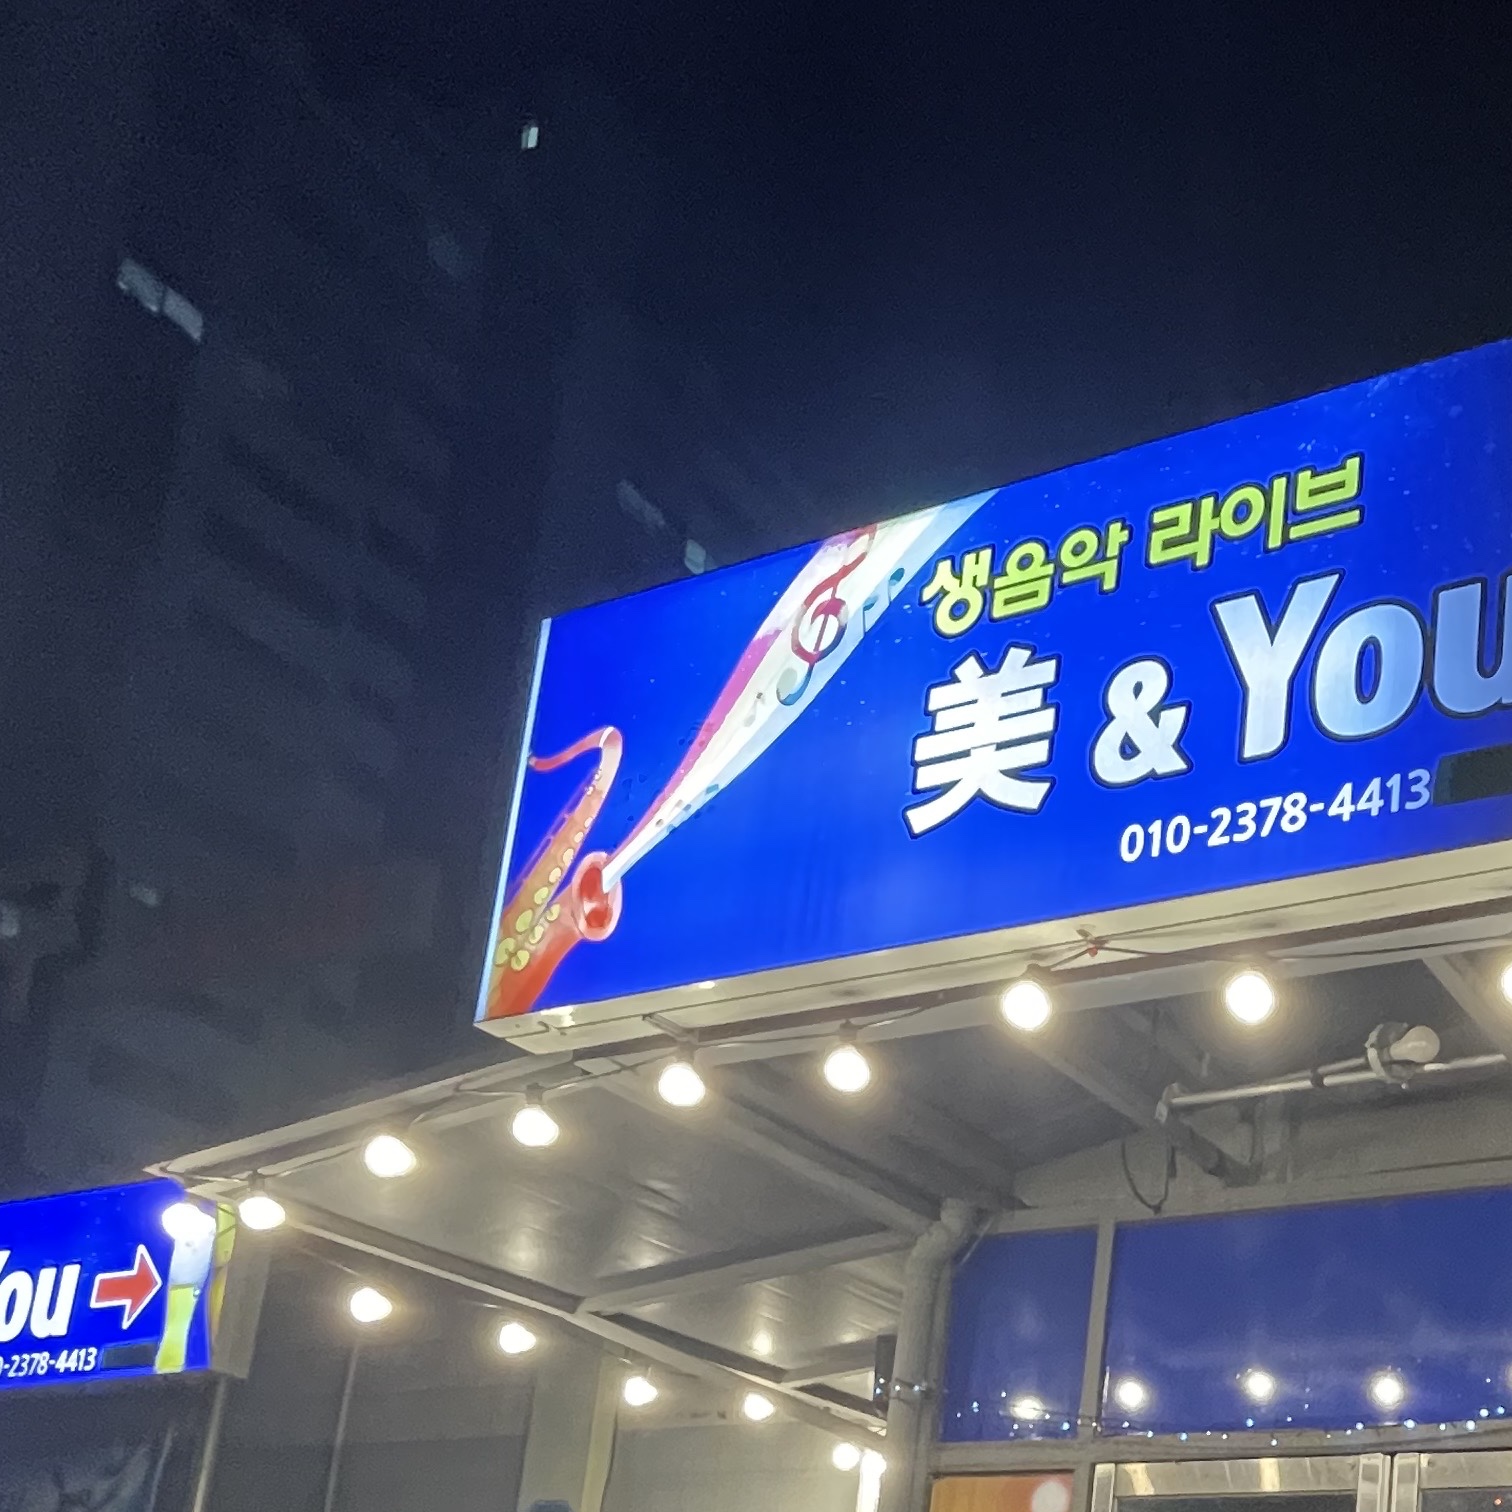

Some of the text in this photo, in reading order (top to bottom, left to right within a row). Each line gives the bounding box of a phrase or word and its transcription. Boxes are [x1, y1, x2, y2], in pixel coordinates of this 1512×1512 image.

[922, 456, 1363, 636] 생음악 라이브
[905, 647, 1060, 836] 美
[1093, 659, 1193, 783] &
[1120, 770, 1432, 864] 010-2378-4413
[0, 1250, 81, 1341] ou
